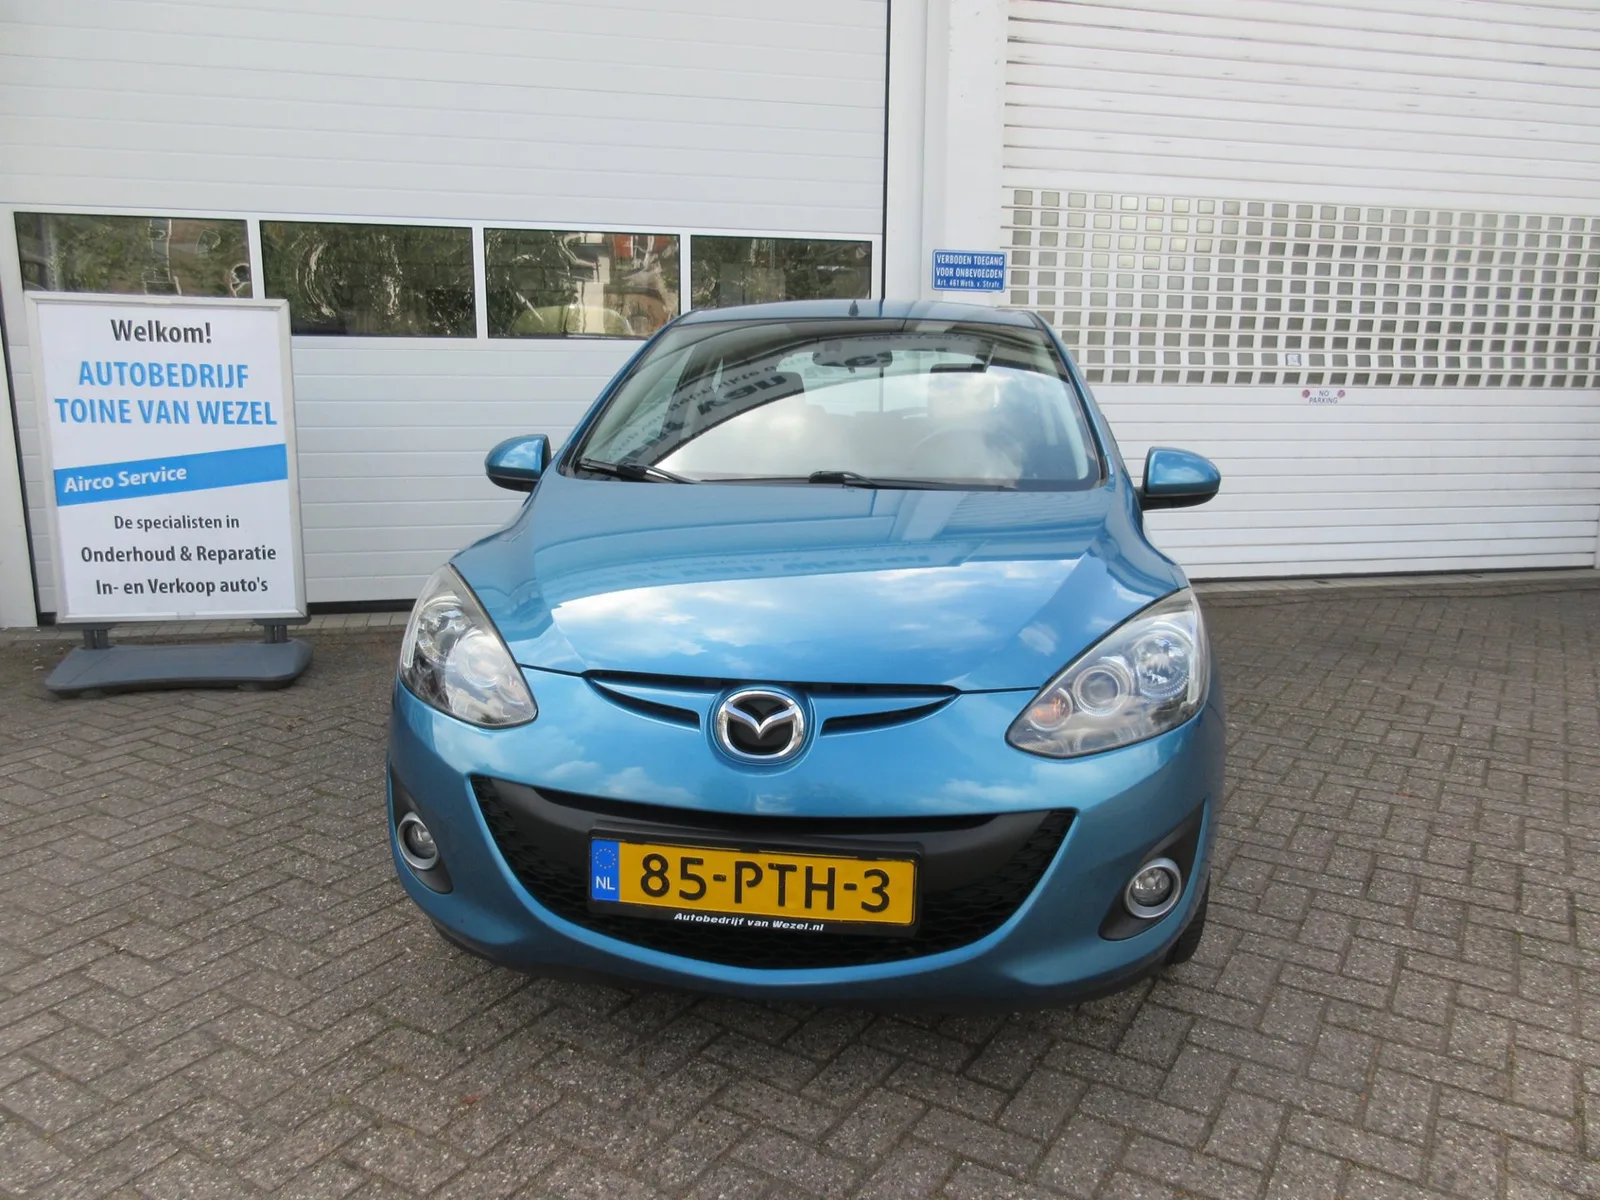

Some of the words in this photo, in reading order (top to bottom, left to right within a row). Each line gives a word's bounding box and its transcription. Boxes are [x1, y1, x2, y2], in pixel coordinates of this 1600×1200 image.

[937, 254, 972, 264] VERBODEN
[974, 255, 1003, 266] TOEGANG
[936, 267, 954, 277] VOOR
[955, 268, 1003, 278] ONBEVOEGDEN
[111, 319, 212, 344] Welkom!
[78, 360, 249, 389] AUTOBEDRIJF
[54, 398, 132, 424] TOINE
[137, 399, 190, 425] VAN
[197, 401, 278, 426] WEZEL
[64, 476, 115, 494] Airco
[118, 466, 187, 488] Service
[113, 515, 133, 530] De
[136, 515, 223, 533] specialisten
[226, 514, 240, 529] in
[80, 546, 176, 563] Onderhoud
[180, 546, 193, 562] &
[196, 545, 277, 565] Reparatie
[96, 579, 119, 595] In-
[123, 582, 144, 595] en
[147, 578, 216, 597] Verkoop
[220, 576, 268, 593] auto's
[595, 875, 616, 891] NL
[640, 853, 890, 913] 85-PTH-3
[674, 912, 745, 927] Autobedrijf
[747, 919, 769, 928] van
[772, 920, 825, 932] Wezel.nl
